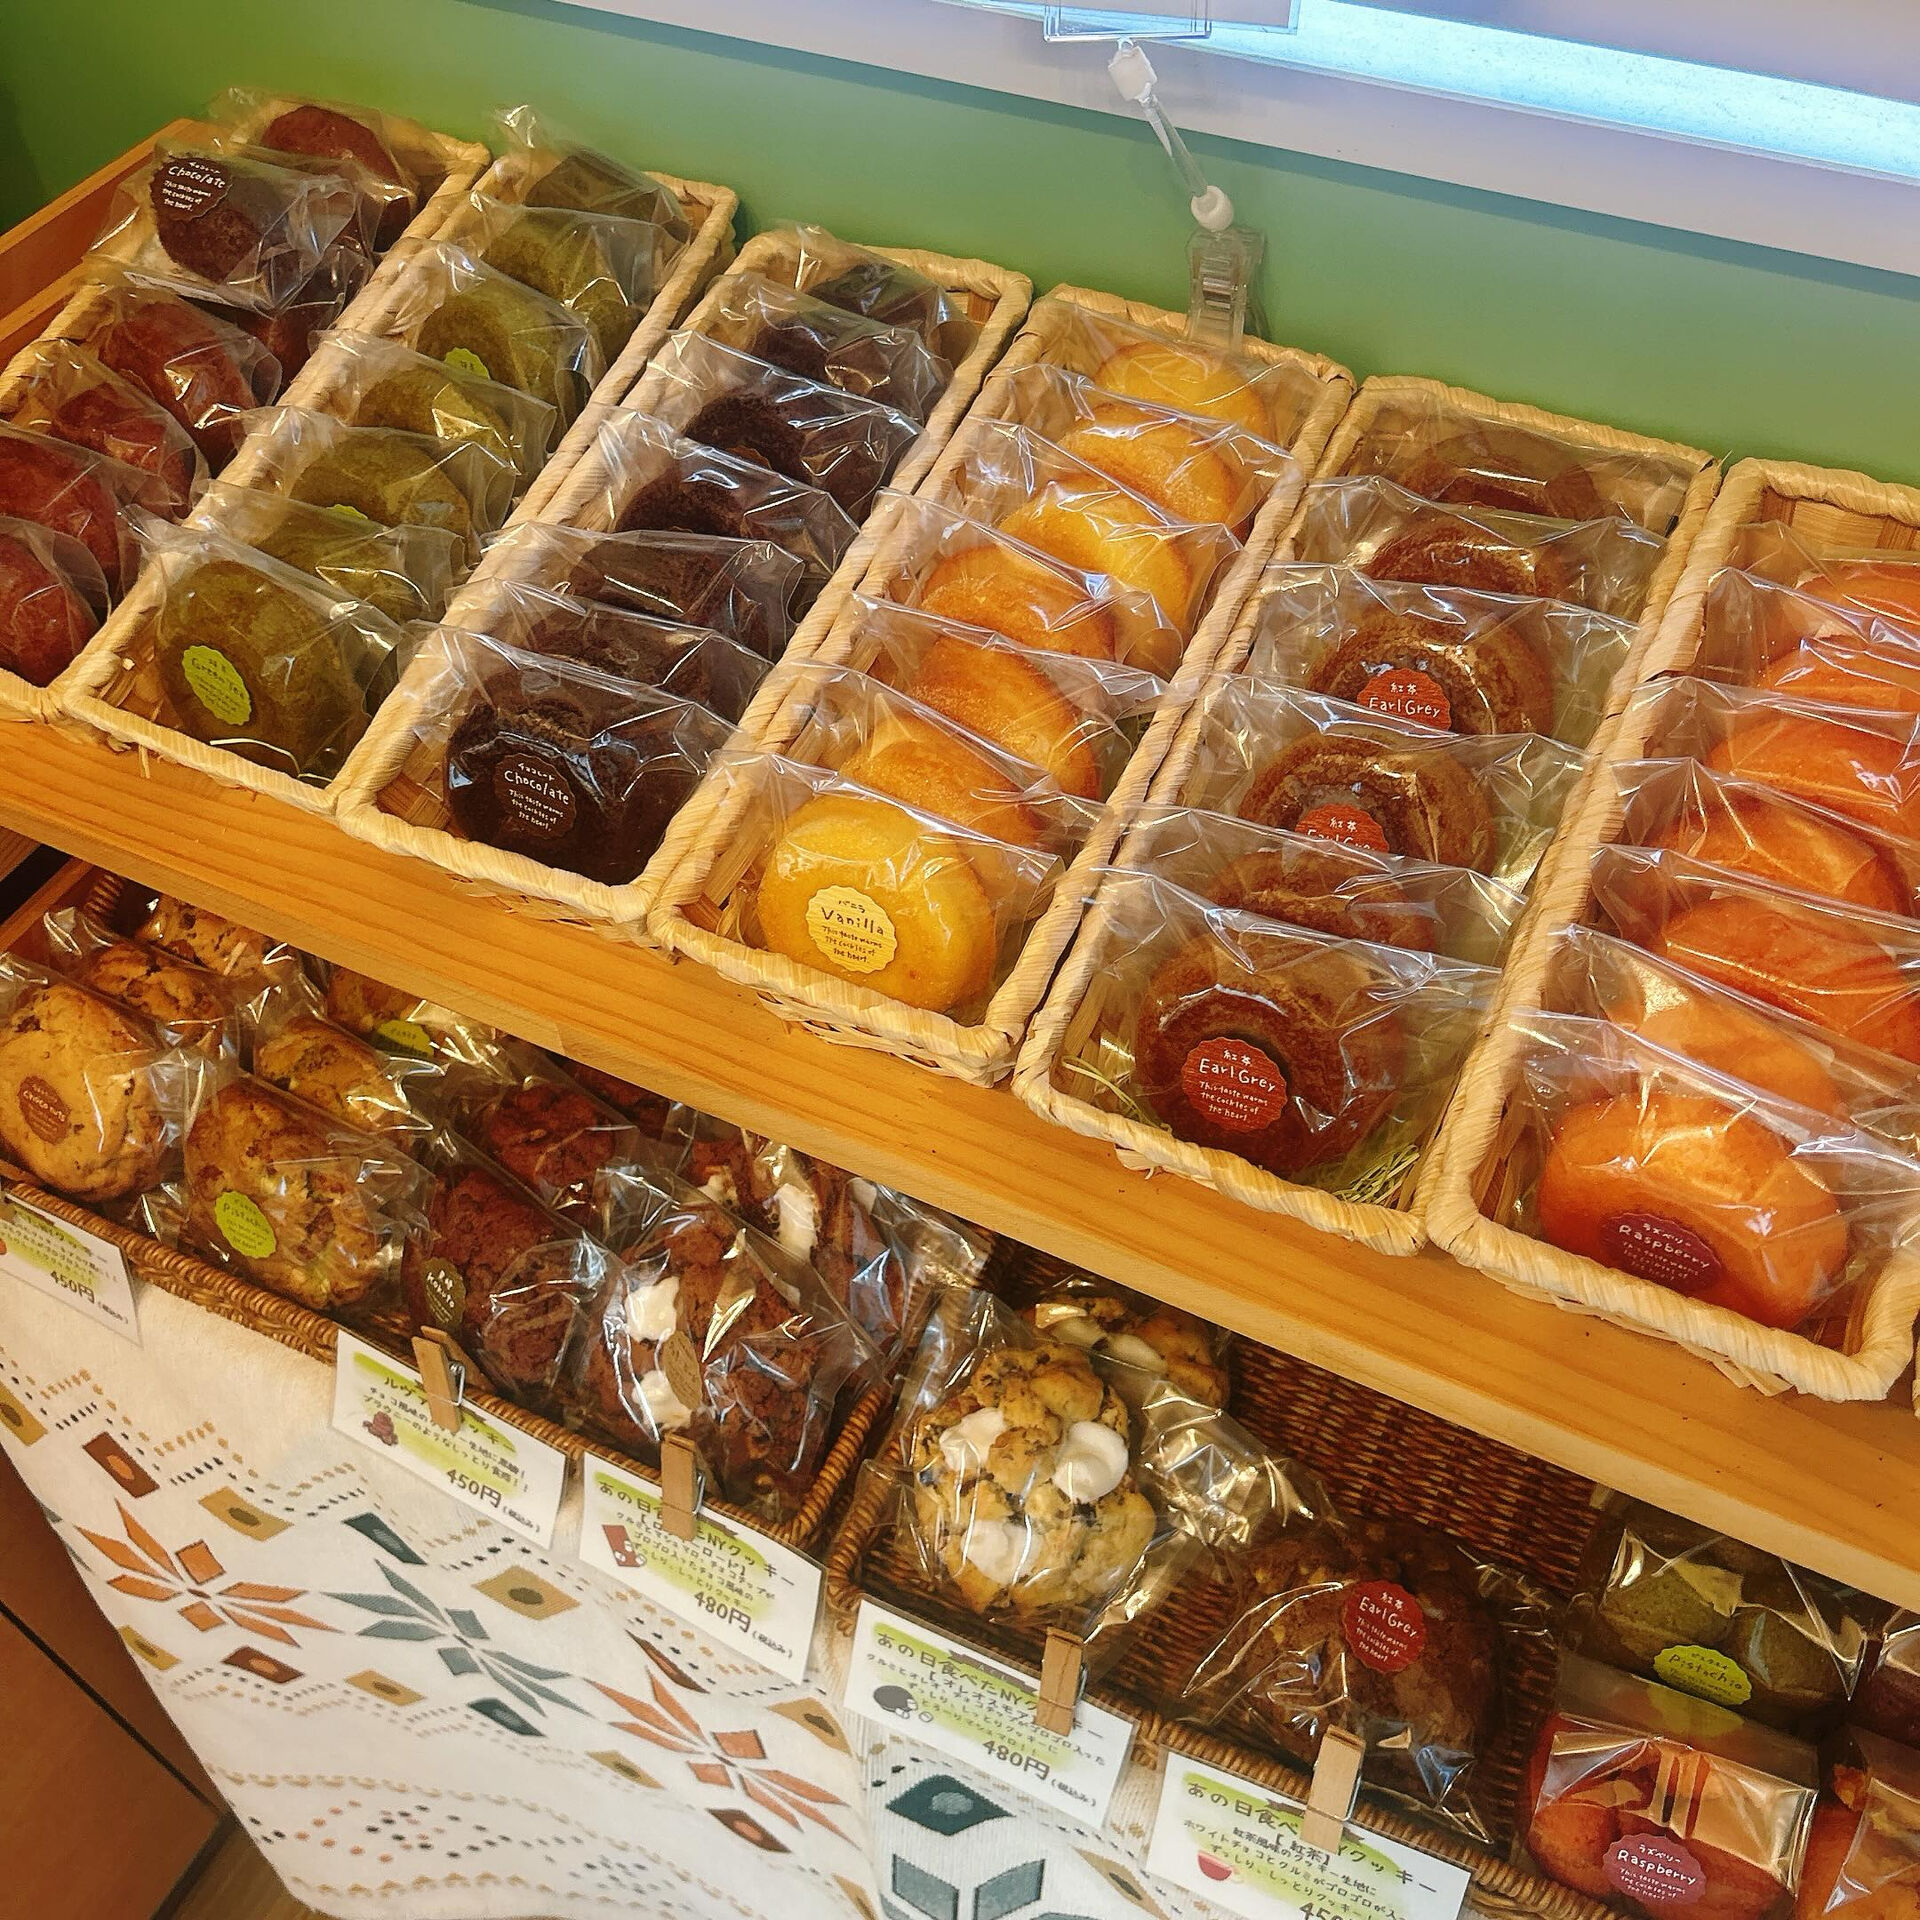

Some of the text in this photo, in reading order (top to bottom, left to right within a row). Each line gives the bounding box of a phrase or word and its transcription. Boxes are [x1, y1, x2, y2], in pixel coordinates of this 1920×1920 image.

[168, 166, 226, 188] Chocolate
[1389, 682, 1417, 694] 紅茶
[1405, 700, 1441, 718] Grey
[504, 770, 569, 805] Chocolate
[517, 762, 555, 781] チョコレート
[1329, 816, 1357, 832] 紅茶
[821, 906, 884, 936] Vanilla
[838, 900, 866, 914] バニラ
[1223, 1048, 1252, 1066] 紅茶
[1199, 1057, 1276, 1092] Earl Grey
[1200, 1080, 1268, 1106] This taste warms
[1215, 1096, 1248, 1112] cockles
[1249, 1106, 1260, 1115] of
[1619, 1224, 1710, 1269] Raspberry
[50, 1270, 95, 1304] 450円
[446, 1469, 501, 1509] 450円
[693, 1591, 751, 1634] 480円
[1359, 1596, 1418, 1637] Earl Grey
[1668, 1654, 1743, 1690] Pistachio
[982, 1739, 1050, 1782] 480円
[1274, 1832, 1331, 1867] 【紅茶】
[1639, 1843, 1681, 1863] ラズベリー
[1617, 1849, 1696, 1885] Raspberry
